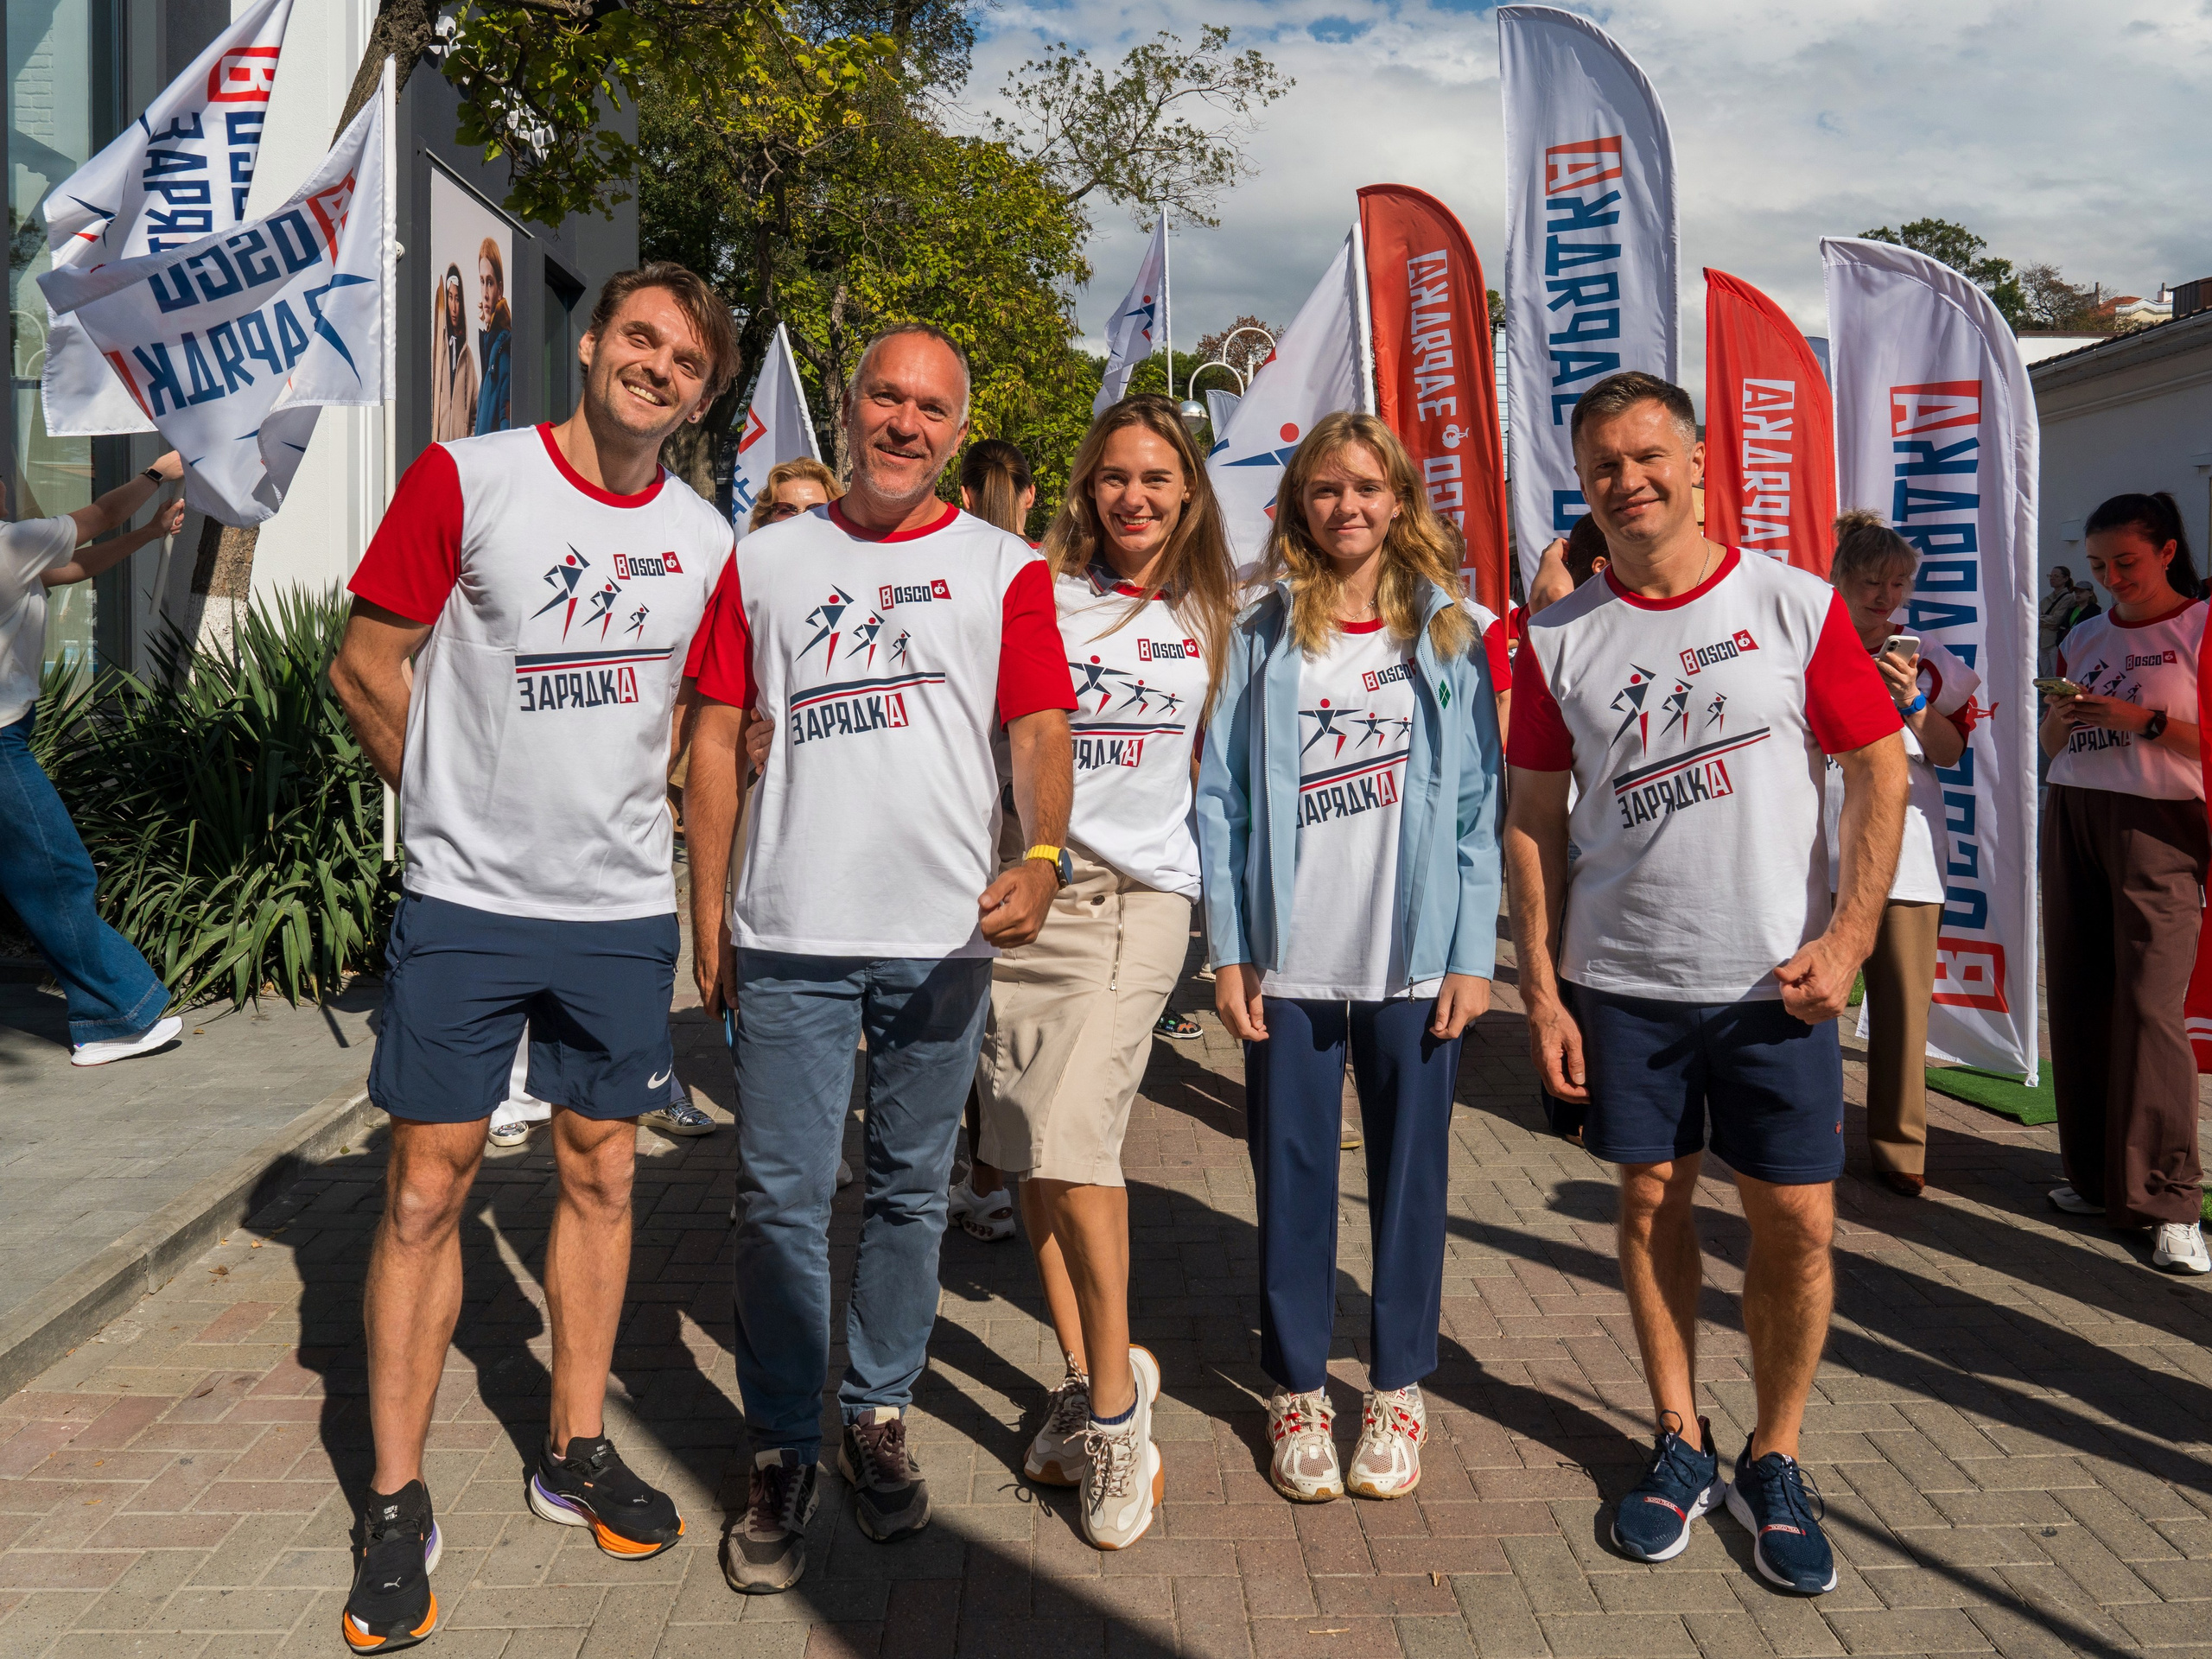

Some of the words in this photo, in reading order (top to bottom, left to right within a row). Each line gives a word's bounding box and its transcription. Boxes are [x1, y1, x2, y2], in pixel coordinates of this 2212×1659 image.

[518, 667, 639, 711] ЗАРЯДКА
[791, 693, 909, 746] ЗАРЯДКА
[1618, 759, 1733, 830] ЗАРЯДКА
